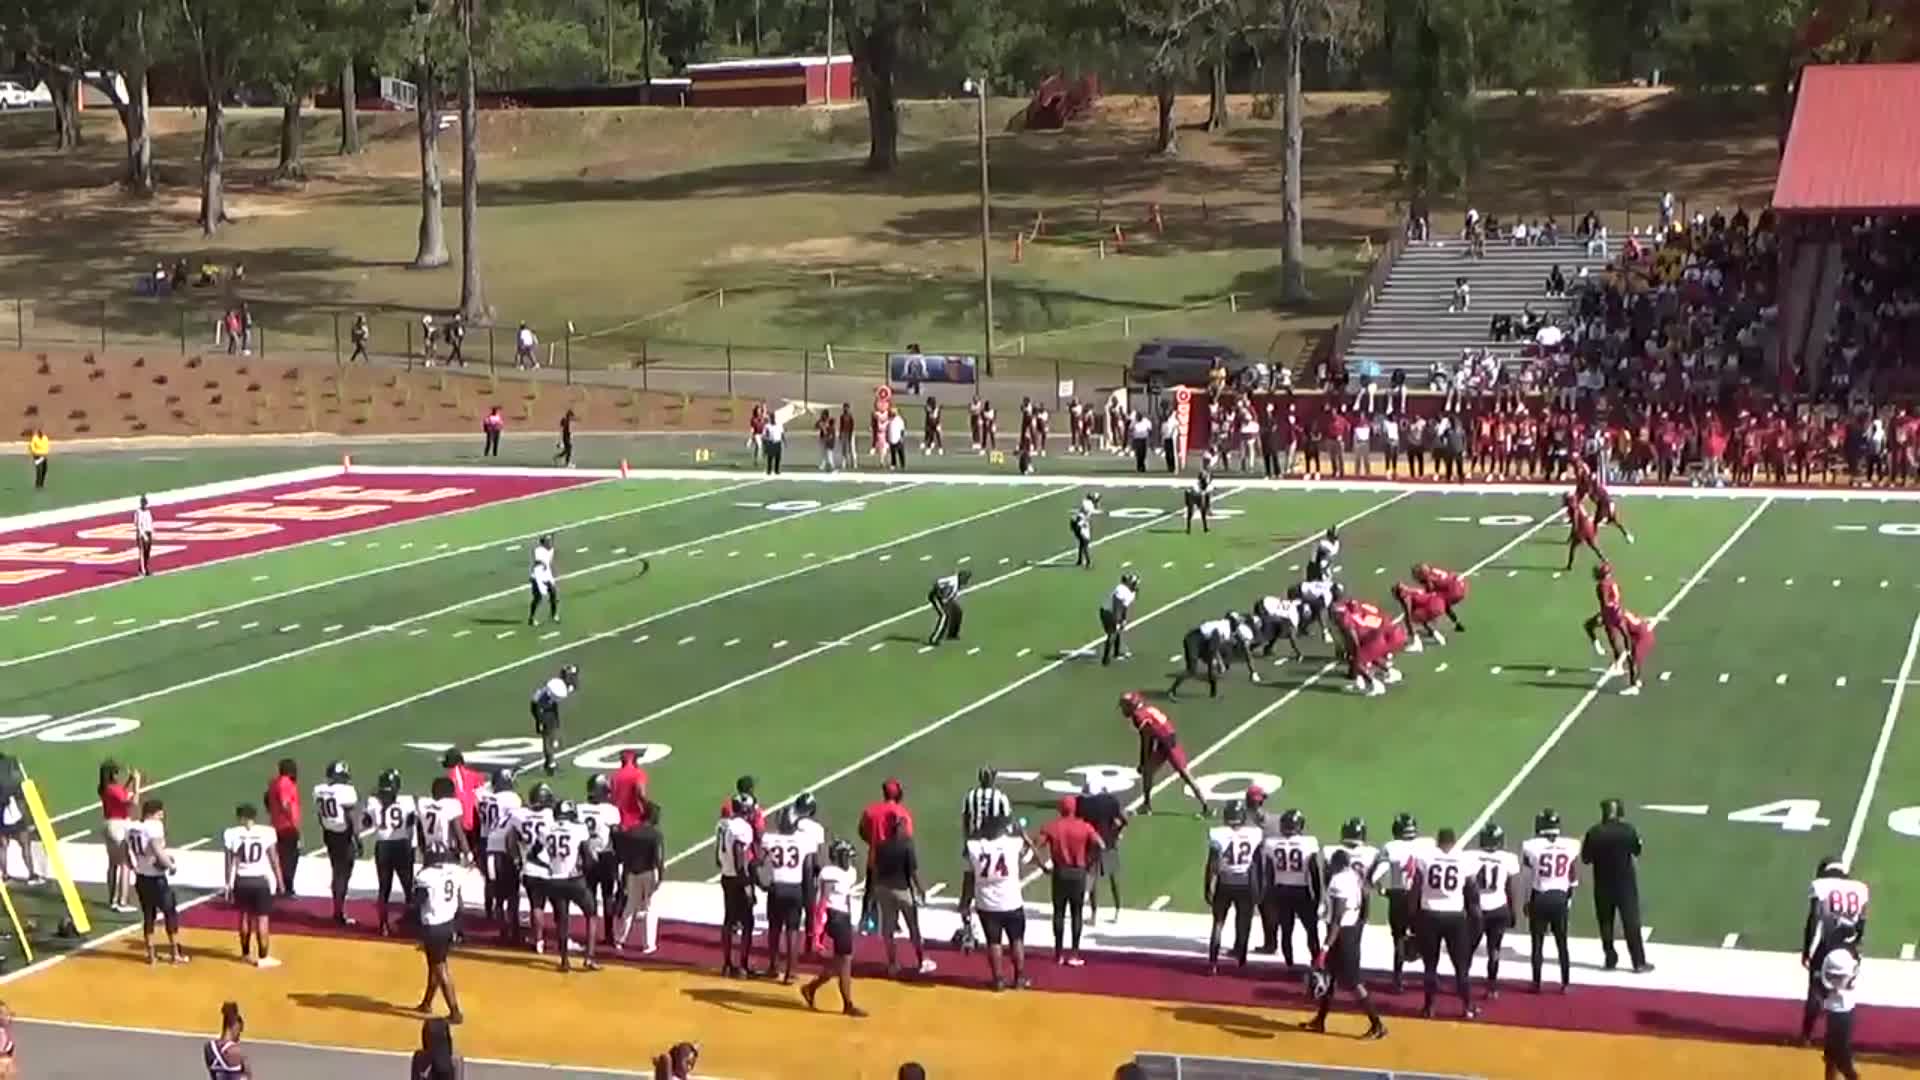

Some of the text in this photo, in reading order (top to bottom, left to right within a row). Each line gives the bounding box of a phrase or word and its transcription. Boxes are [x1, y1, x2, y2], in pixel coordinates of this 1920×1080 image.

[771, 845, 799, 868] 33
[1223, 840, 1251, 865] 42
[978, 853, 1009, 878] 74
[1428, 864, 1459, 891] 66
[1538, 853, 1569, 878] 58
[444, 879, 454, 902] 9
[1476, 865, 1500, 892] 41
[1828, 889, 1860, 918] 88
